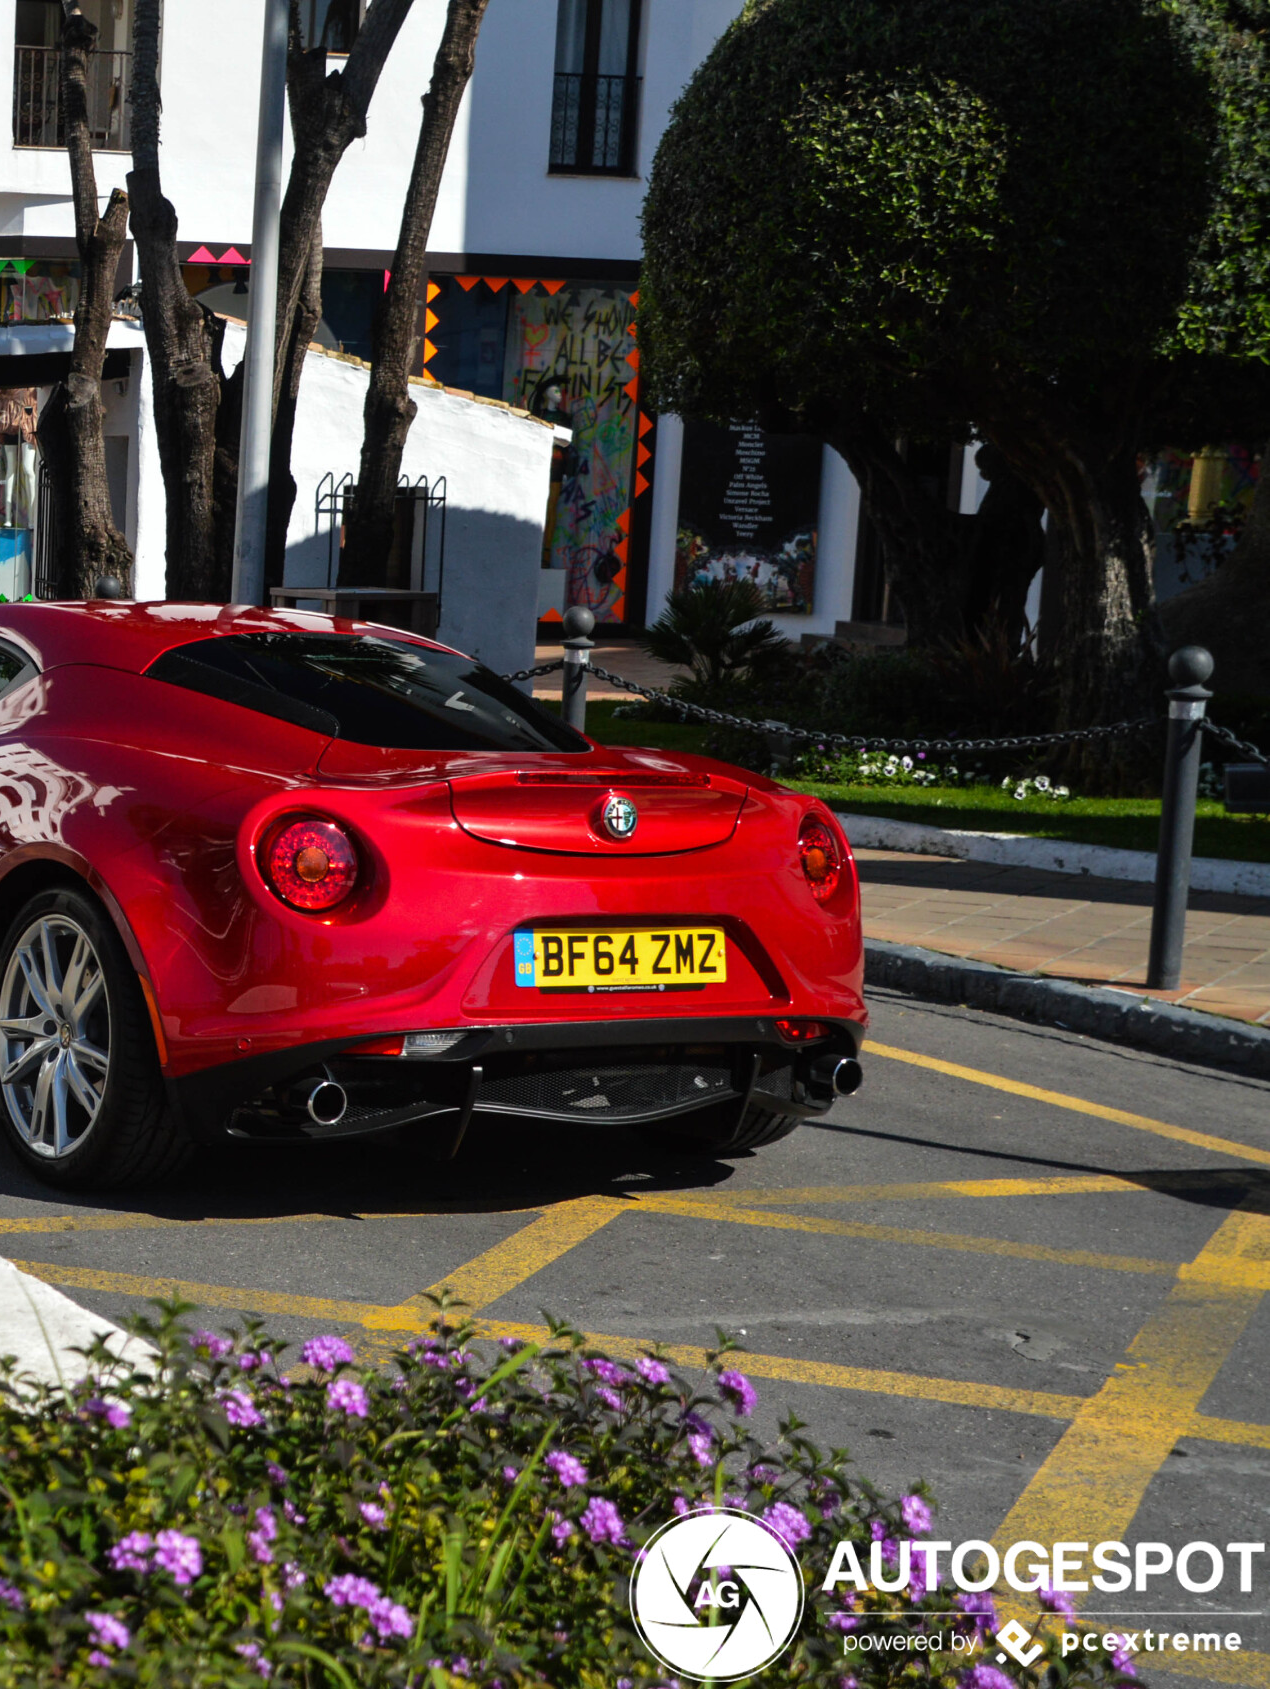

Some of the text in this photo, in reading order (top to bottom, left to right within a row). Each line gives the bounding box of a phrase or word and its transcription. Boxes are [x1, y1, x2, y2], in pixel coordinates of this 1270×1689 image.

[544, 300, 573, 331] WE
[555, 334, 625, 373] ALL BE
[743, 432, 760, 440] MCM
[745, 482, 767, 490] Angels
[749, 498, 771, 506] Project
[734, 505, 759, 513] Versace
[719, 513, 773, 522] Victoria Beckham
[541, 933, 717, 977] BF64 ZMZ
[518, 962, 532, 975] GB
